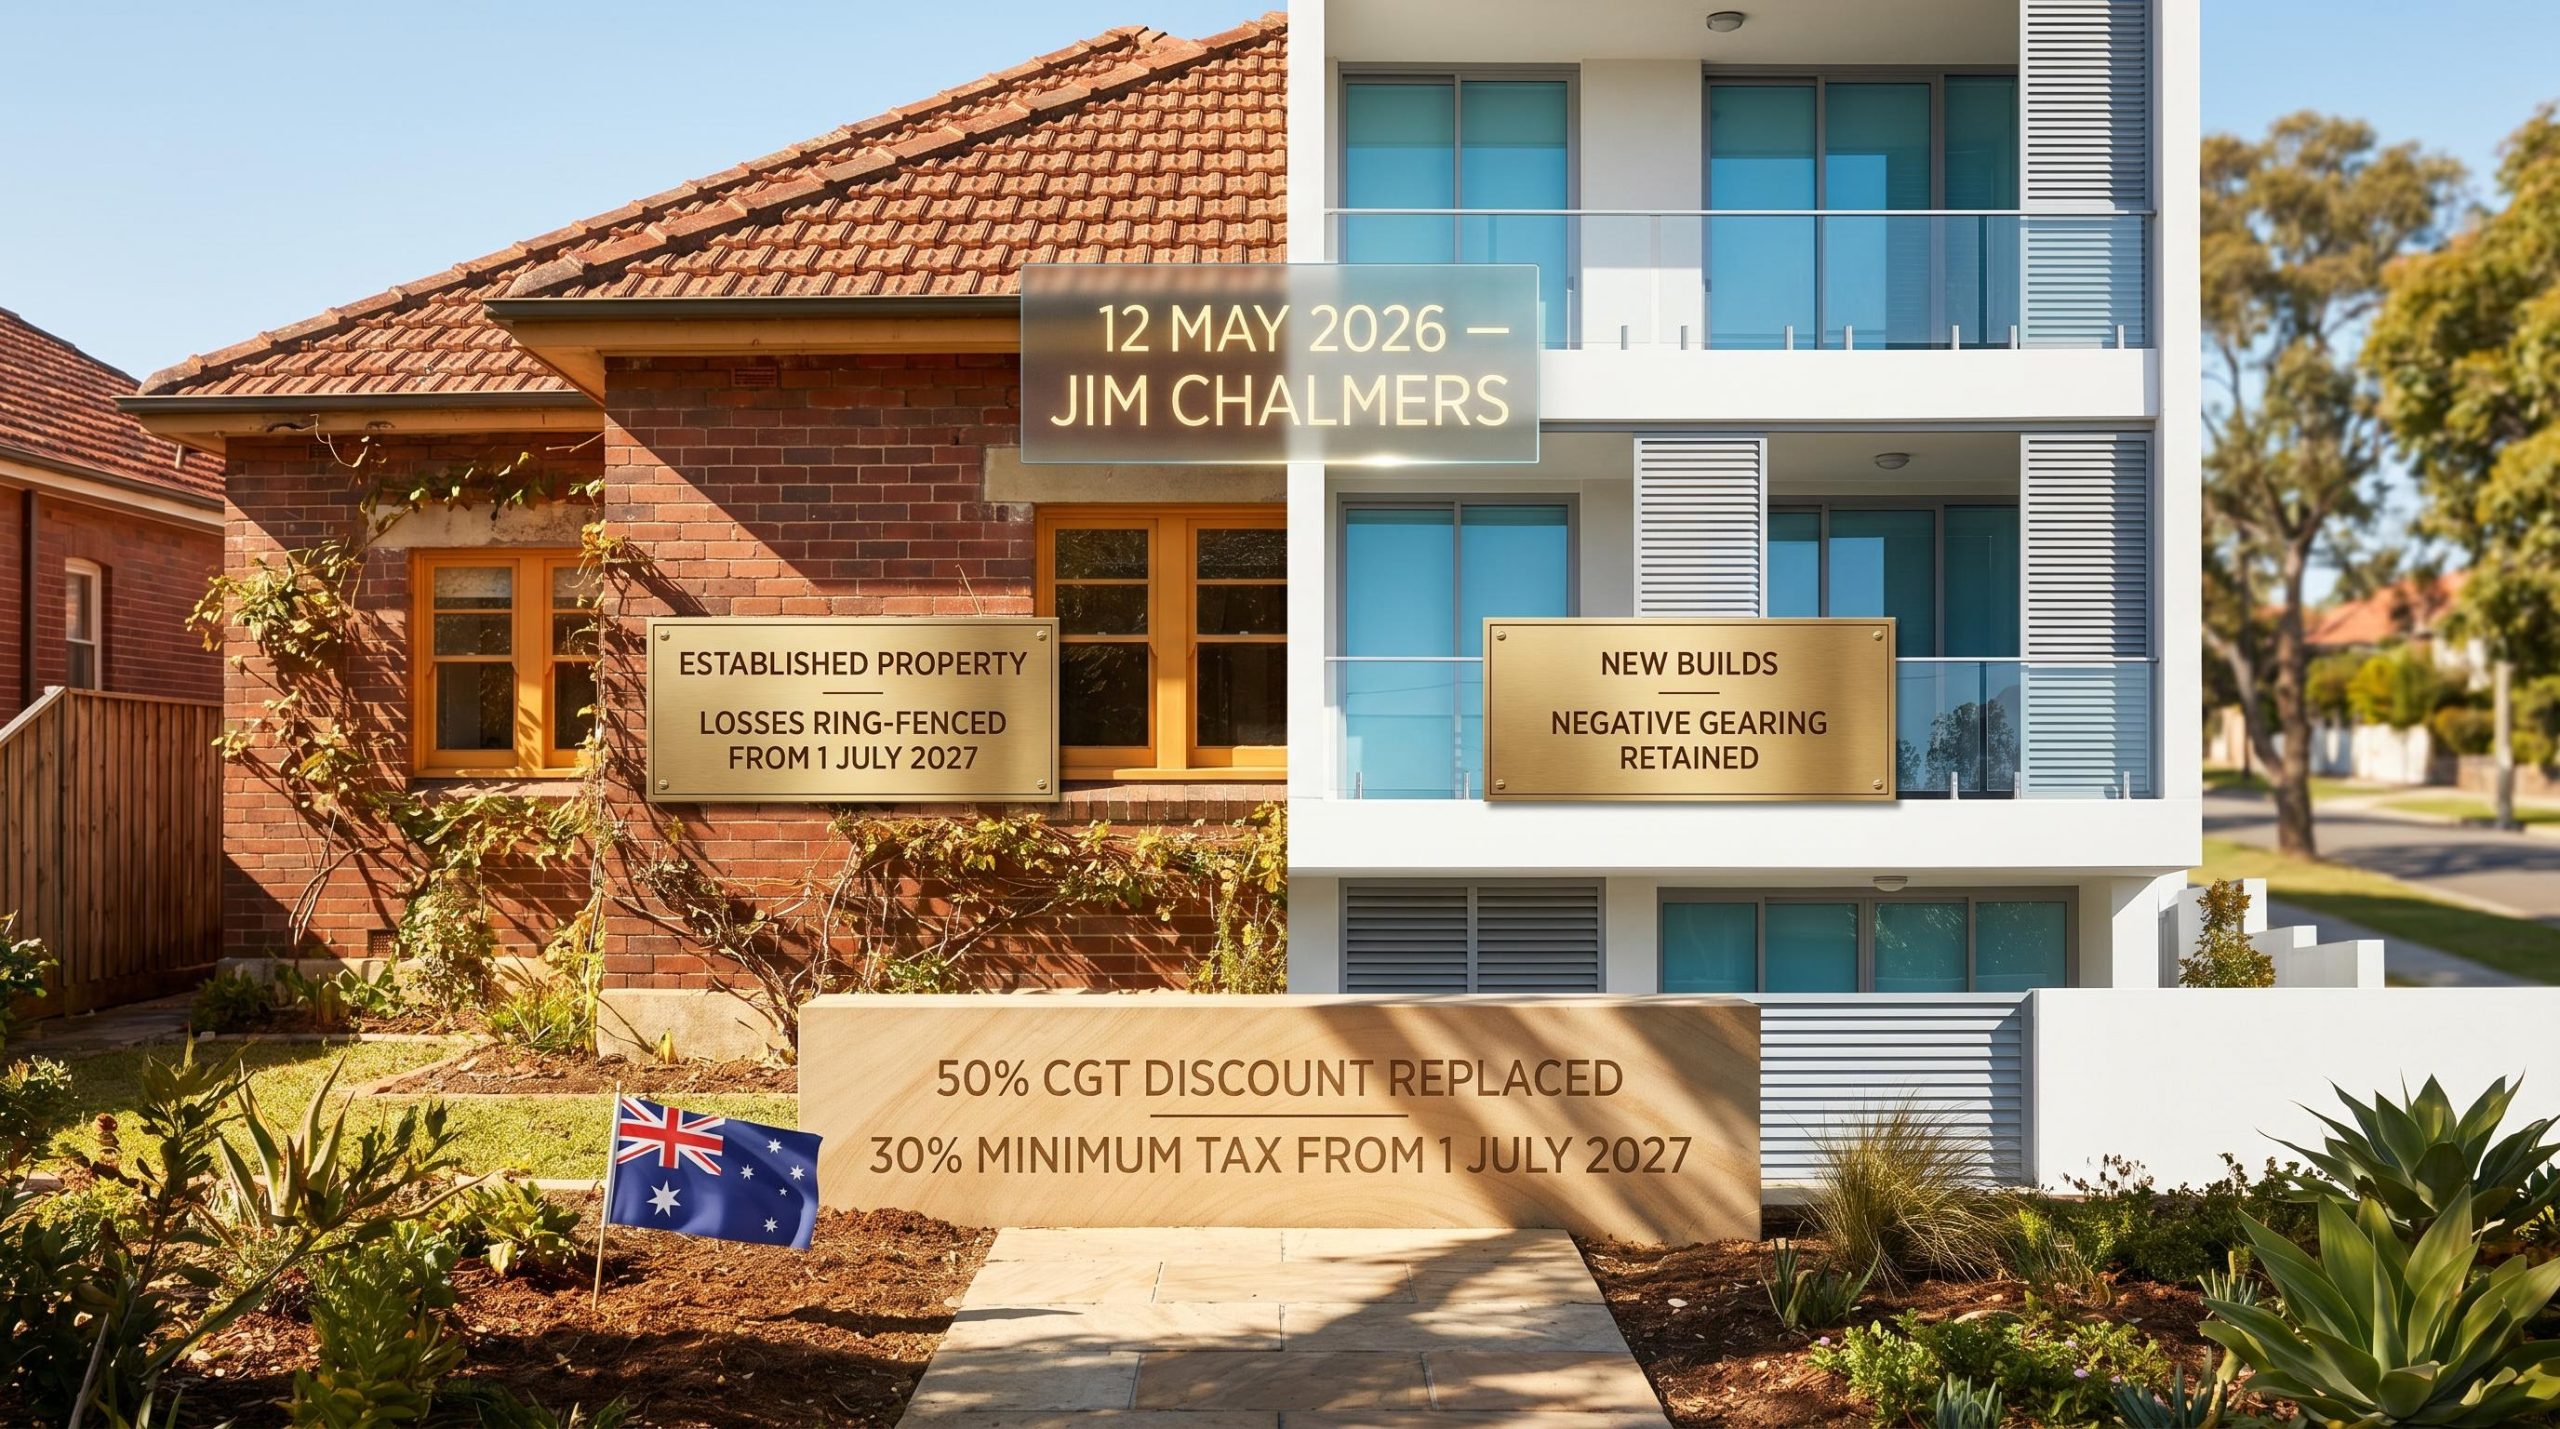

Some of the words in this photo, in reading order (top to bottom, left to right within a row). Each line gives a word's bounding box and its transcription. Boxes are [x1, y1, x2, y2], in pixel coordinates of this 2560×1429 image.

[679, 651, 869, 676] ESTABLISHED
[878, 651, 1028, 676] PROPERTY
[1601, 651, 1667, 676] NEW
[1677, 651, 1778, 676] BUILDS
[700, 710, 804, 735] LOSSES
[814, 710, 1007, 735] RING-FENCED
[1551, 710, 1690, 735] NEGATIVE
[1700, 710, 1828, 735] GEARING
[729, 745, 810, 770] FROM
[817, 745, 827, 770] 1
[835, 745, 903, 770] JULY
[910, 745, 978, 770] 2027
[1620, 745, 1759, 770] RETAINED
[936, 1058, 1029, 1098] 50%
[1042, 1058, 1130, 1098] CGT
[1146, 1058, 1376, 1098] DISCOUNT
[1390, 1058, 1624, 1098] REPLACED
[869, 1136, 963, 1175] 30%
[977, 1136, 1182, 1175] MINIMUM
[1196, 1136, 1282, 1175] TAX
[1298, 1136, 1424, 1175] FROM
[1437, 1136, 1453, 1175] 1
[1465, 1136, 1574, 1175] JULY
[1585, 1136, 1693, 1175] 2027
